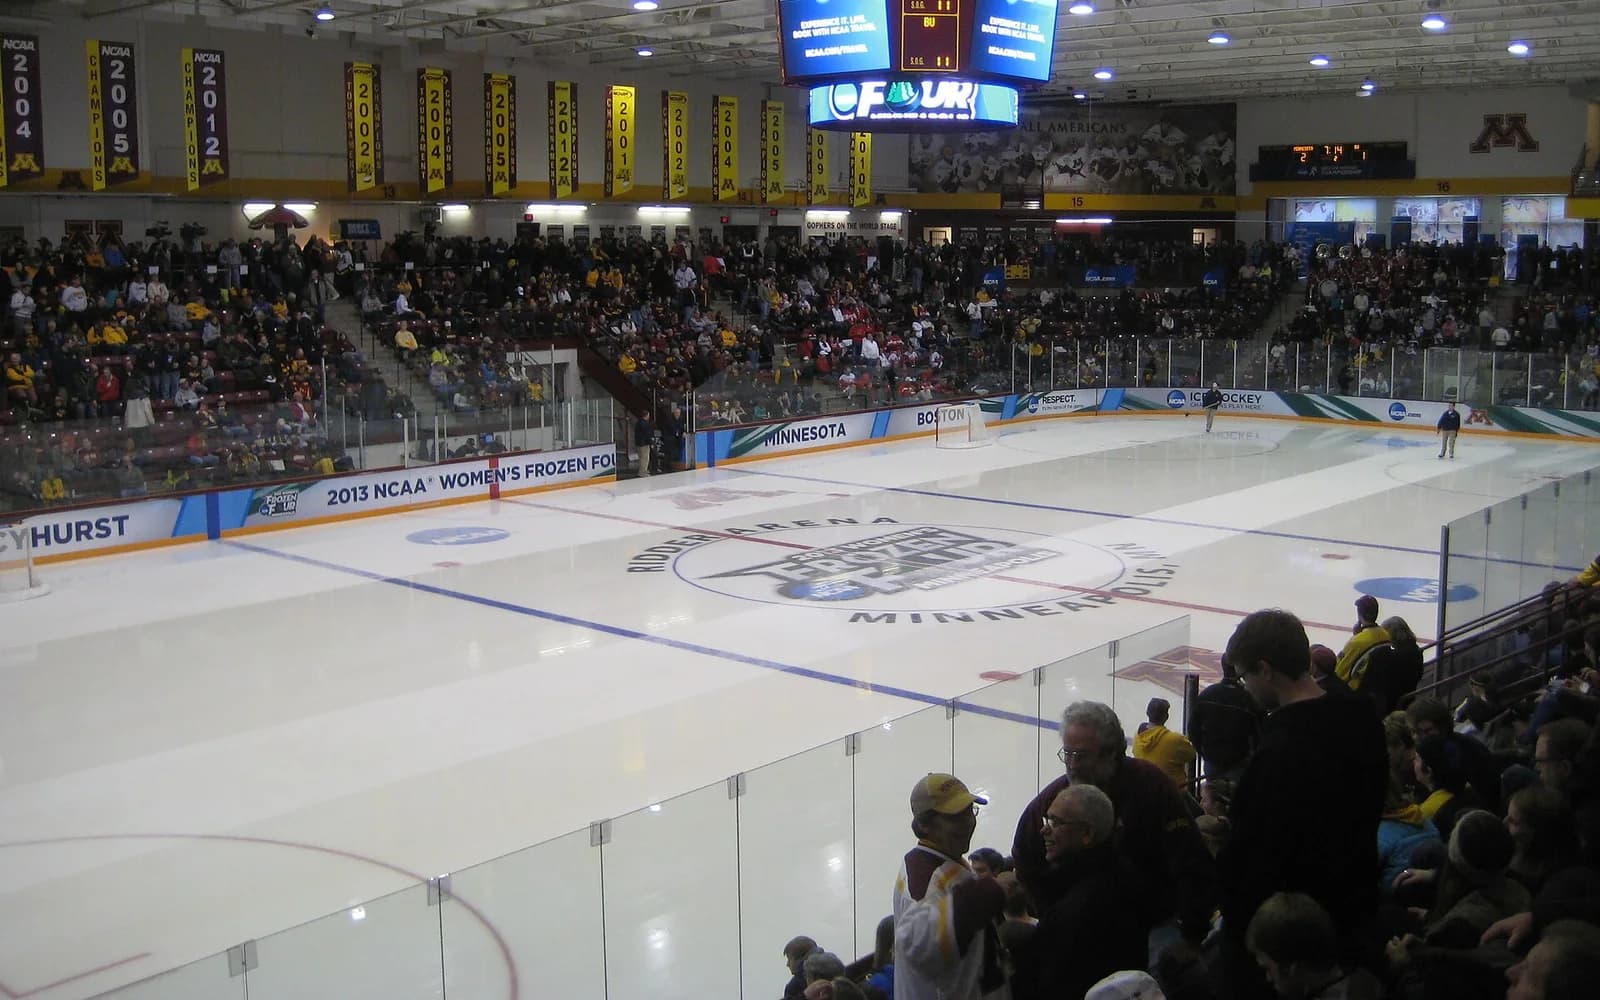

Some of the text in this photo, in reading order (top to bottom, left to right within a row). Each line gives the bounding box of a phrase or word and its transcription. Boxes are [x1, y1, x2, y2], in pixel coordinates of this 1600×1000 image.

[923, 16, 936, 28] BU
[3, 39, 35, 51] NCAA
[101, 45, 131, 57] NCAA
[194, 53, 221, 64] NCAA
[13, 54, 32, 138] 2004
[109, 60, 129, 153] 2005
[202, 66, 221, 156] 2012
[89, 55, 103, 183] CHAMPIONS
[184, 62, 197, 183] CHAMPIONS
[359, 83, 370, 157] 2002
[430, 90, 441, 159] 2004
[495, 94, 506, 166] 2005
[558, 102, 568, 172] 2012
[620, 102, 628, 165] 2001
[724, 110, 732, 169] 2004
[1049, 121, 1128, 135] AMERICANS
[772, 115, 780, 172] 2005
[816, 134, 824, 175] 009
[1300, 153, 1307, 162] 2
[1071, 197, 1084, 208] 15
[1436, 182, 1450, 192] 16
[807, 221, 897, 231] GOPHERS ON THE WORLD STAGE
[917, 408, 965, 426] BOSTON
[1222, 393, 1262, 404] OCKEY
[764, 422, 847, 447] MINNESOTA
[266, 494, 297, 505] FROZEN
[327, 485, 369, 506] 2013
[439, 465, 521, 490] WOMEN'S
[525, 457, 588, 479] FROZEN
[626, 516, 900, 573] RIDDER ARENA
